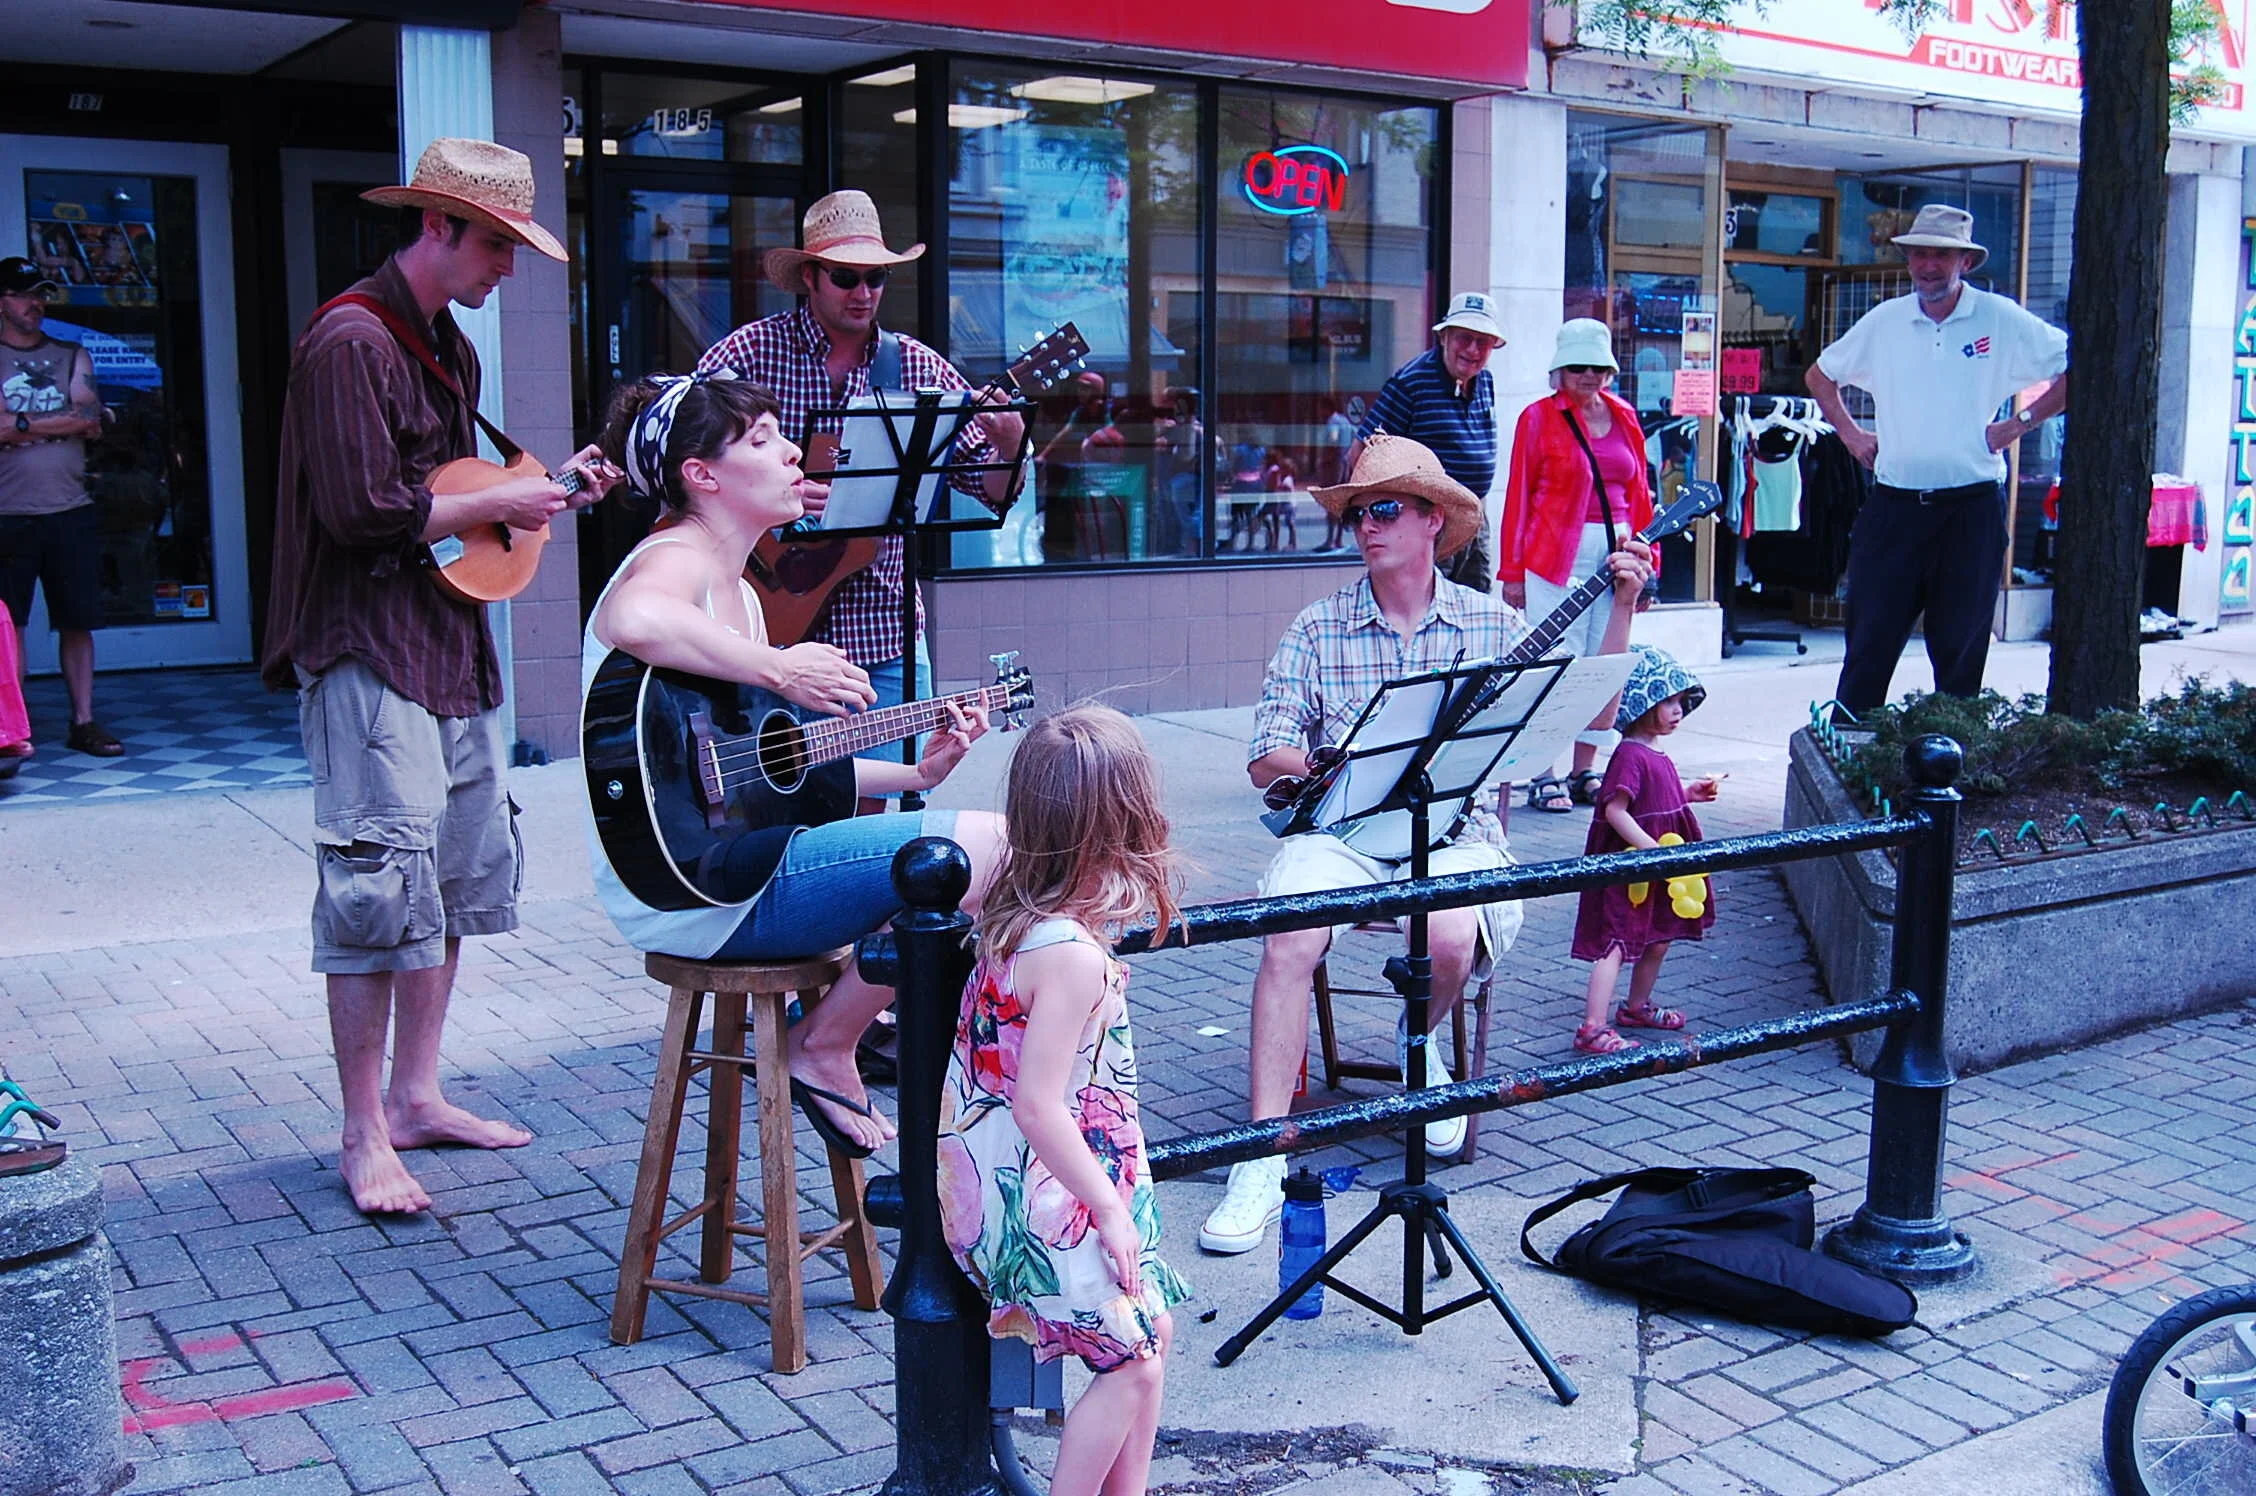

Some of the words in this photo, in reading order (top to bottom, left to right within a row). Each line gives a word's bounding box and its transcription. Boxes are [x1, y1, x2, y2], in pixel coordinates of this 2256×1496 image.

[1928, 39, 2077, 86] FOOTWEAR
[656, 110, 710, 132] 185
[1246, 151, 1346, 212] OPEN
